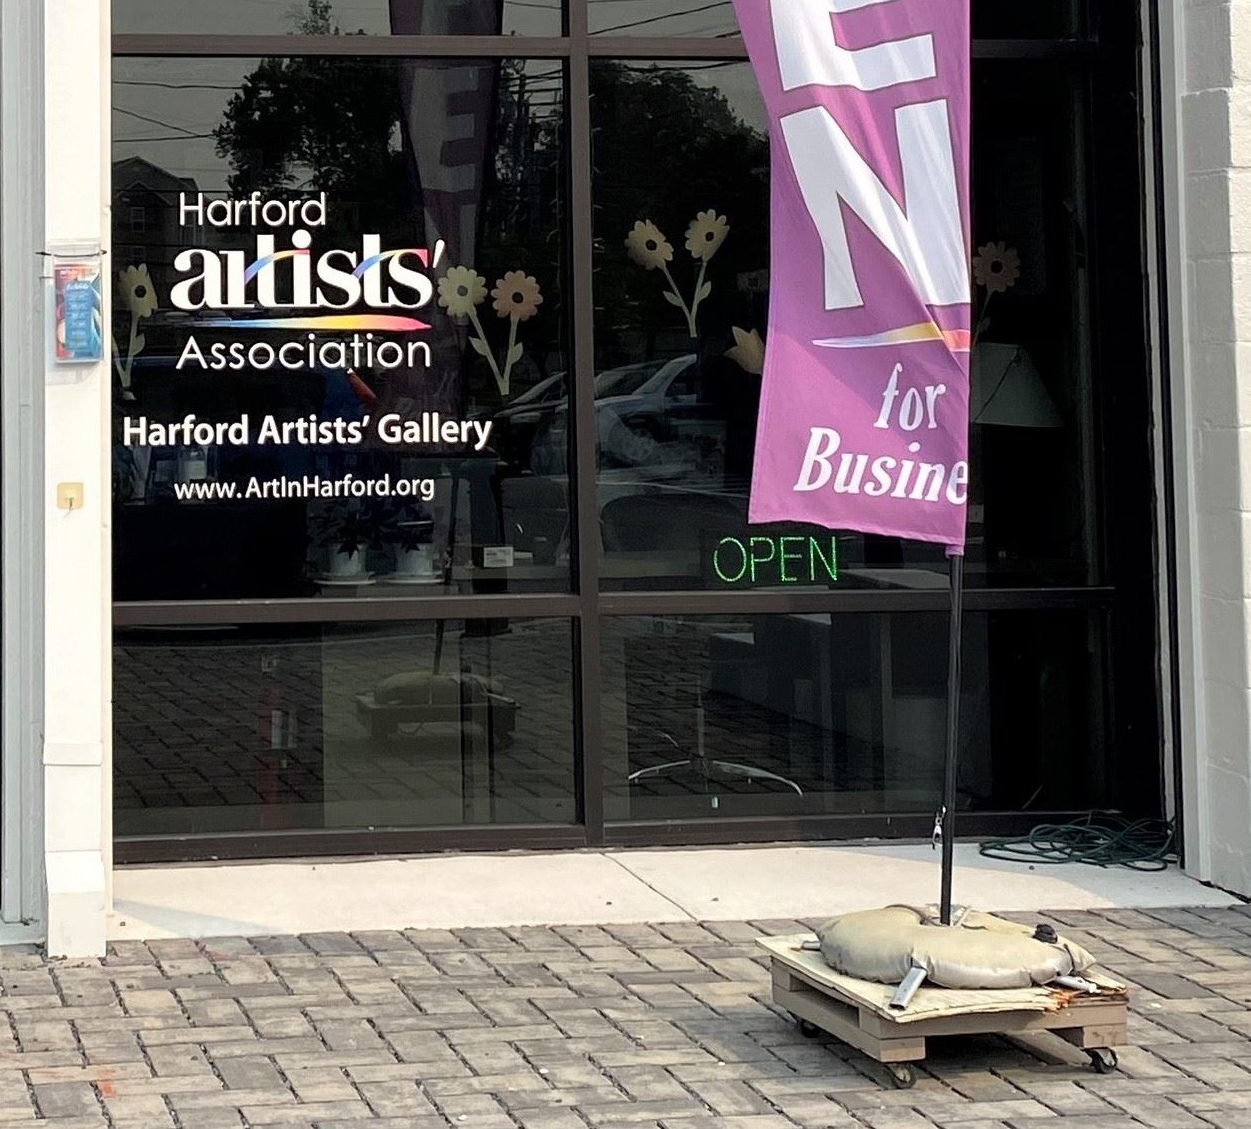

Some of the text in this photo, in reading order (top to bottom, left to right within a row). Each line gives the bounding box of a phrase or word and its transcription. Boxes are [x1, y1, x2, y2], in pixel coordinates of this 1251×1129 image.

[179, 191, 327, 226] Harford
[170, 229, 445, 310] artists'
[175, 333, 431, 370] Association
[873, 362, 946, 431] for
[123, 414, 248, 446] Harford
[378, 412, 492, 451] Gallery
[173, 474, 435, 502] www.ArtInHarford.org
[713, 536, 837, 582] OPEN
